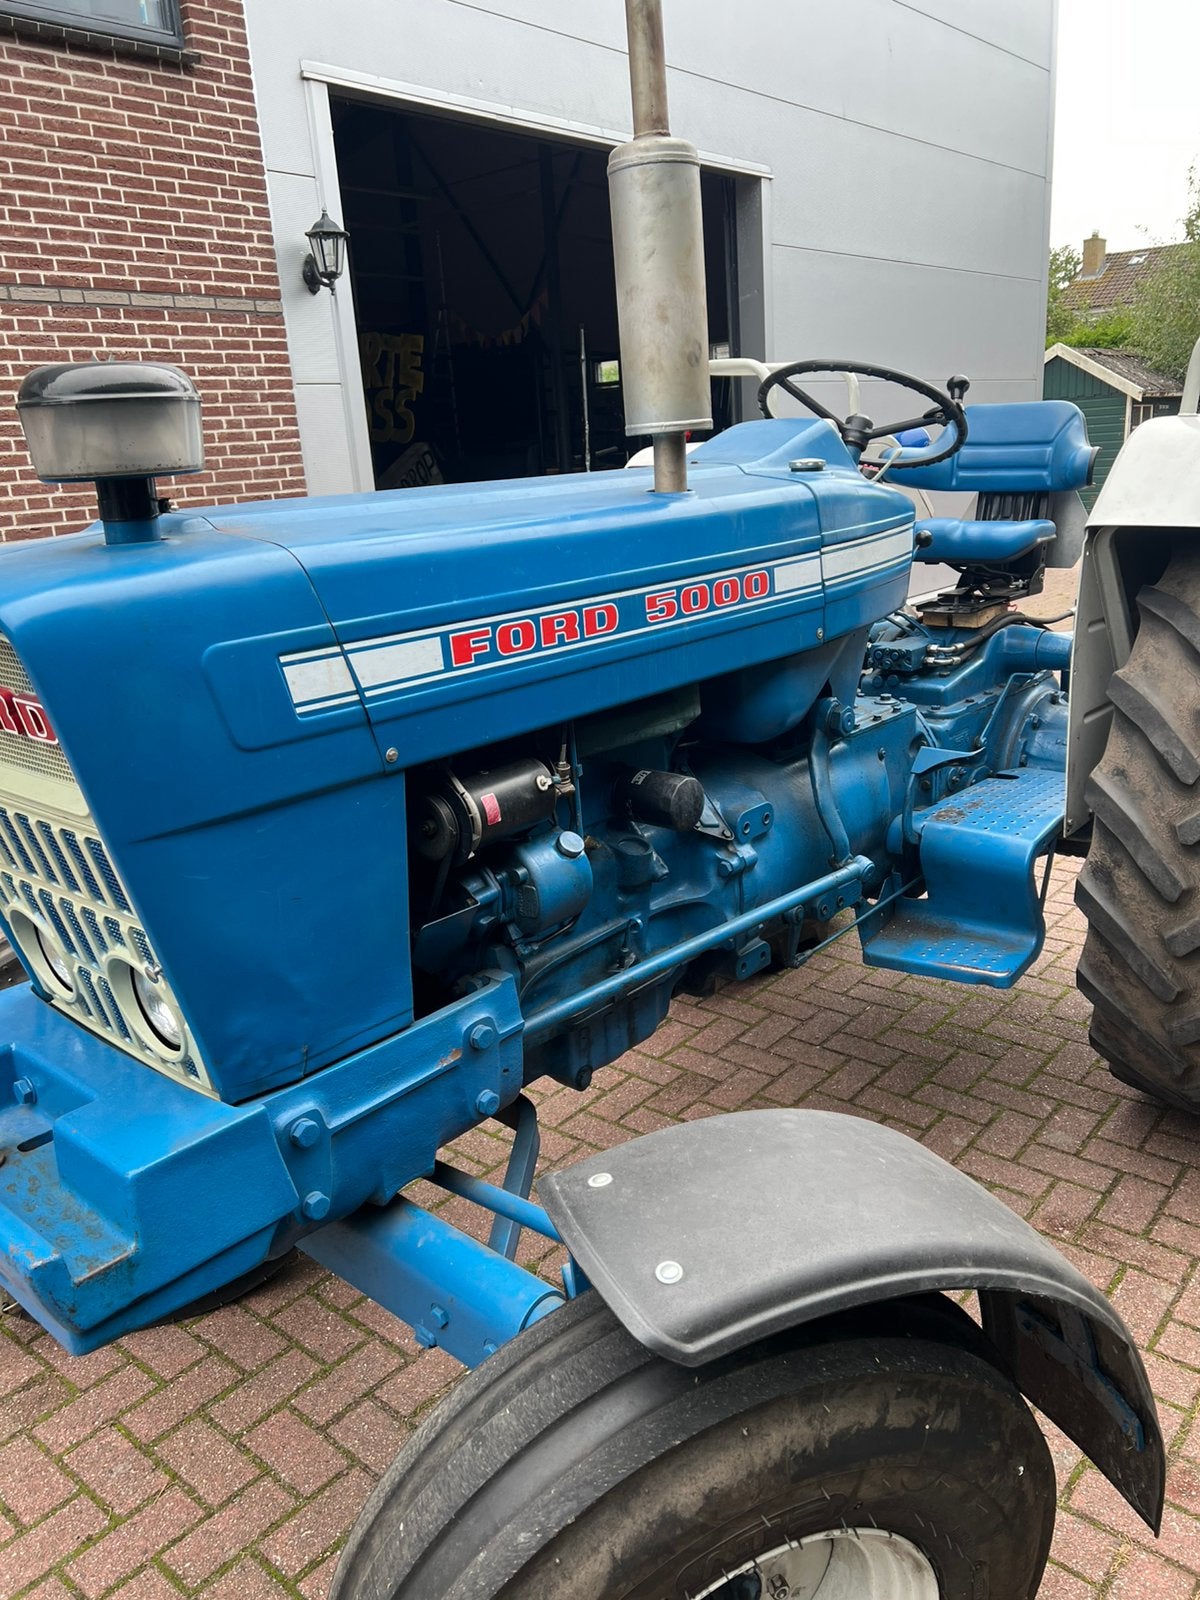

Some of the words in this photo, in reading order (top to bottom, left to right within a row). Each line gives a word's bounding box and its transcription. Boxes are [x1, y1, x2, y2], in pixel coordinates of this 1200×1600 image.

[365, 387, 416, 444] SS
[449, 603, 619, 668] FORD
[645, 570, 770, 623] 5000
